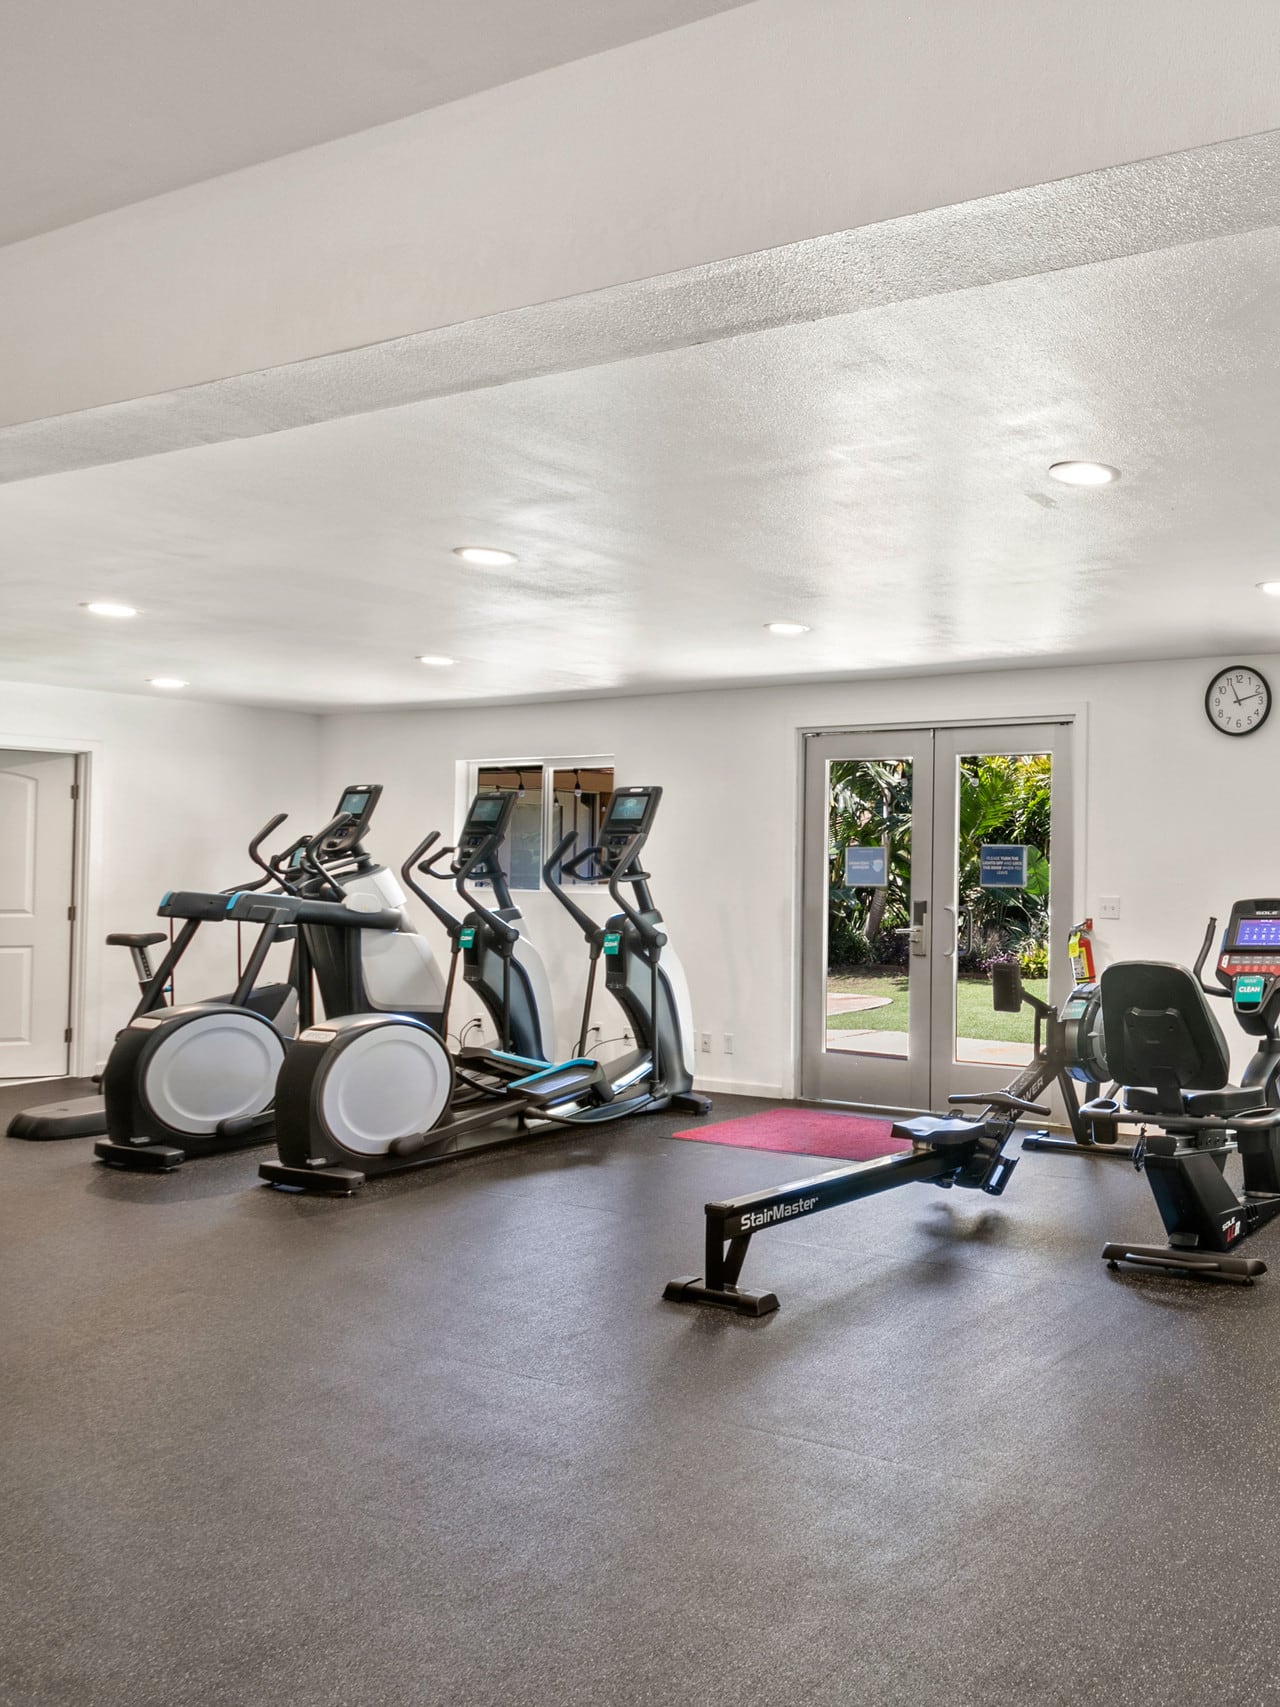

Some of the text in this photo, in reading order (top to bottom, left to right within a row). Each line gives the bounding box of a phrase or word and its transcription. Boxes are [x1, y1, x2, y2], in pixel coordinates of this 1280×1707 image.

[1226, 677, 1233, 686] 11
[1235, 674, 1244, 684] 12
[1218, 686, 1227, 695] 10
[1255, 685, 1262, 694] 2
[1214, 697, 1221, 707] 9
[1258, 696, 1264, 705] 3
[1218, 709, 1224, 719] 8
[1254, 708, 1260, 717] 4
[1226, 716, 1232, 725] 7
[1235, 719, 1242, 728] 6
[1247, 716, 1252, 725] 5
[740, 1198, 817, 1231] StairMaster
